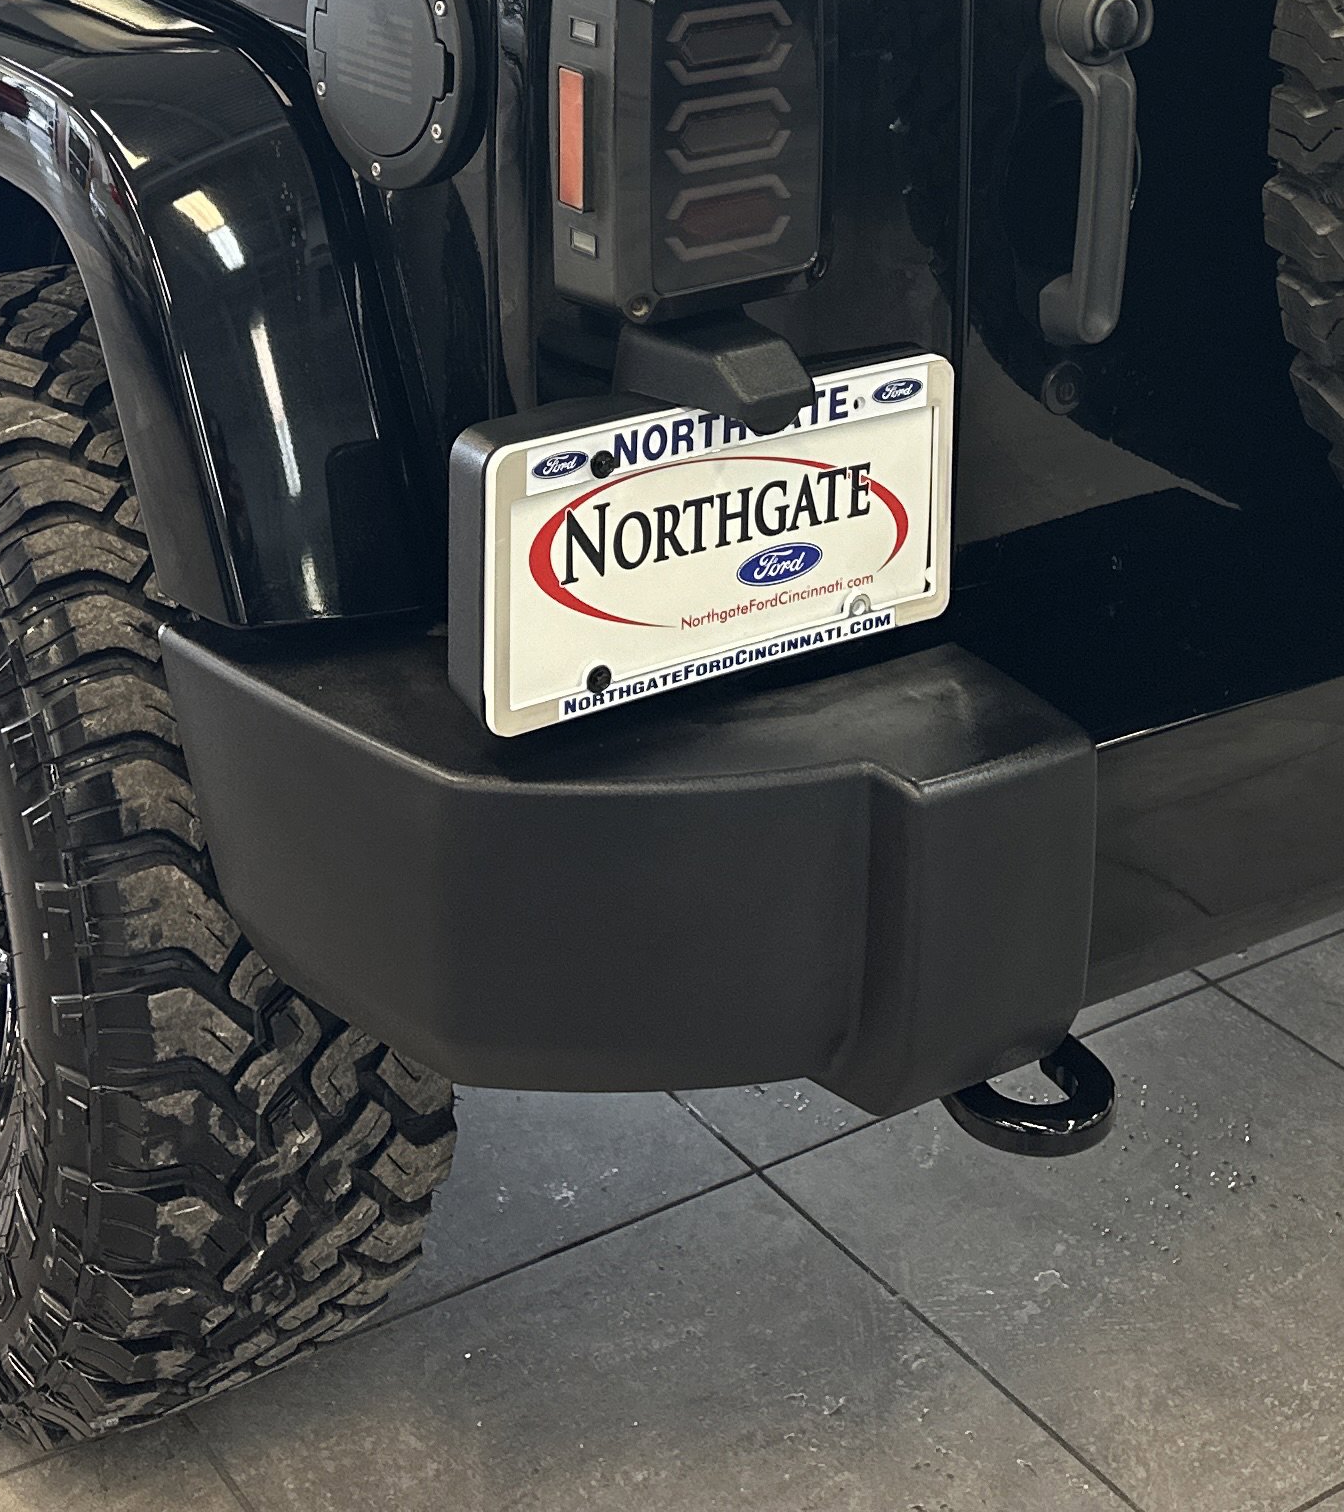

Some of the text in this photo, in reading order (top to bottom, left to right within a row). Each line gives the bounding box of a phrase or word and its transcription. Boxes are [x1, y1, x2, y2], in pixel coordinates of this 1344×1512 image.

[613, 384, 849, 467] NORTHTE
[559, 462, 871, 586] NORTHGATE
[681, 574, 875, 631] NorthgateFordCincinnati.com
